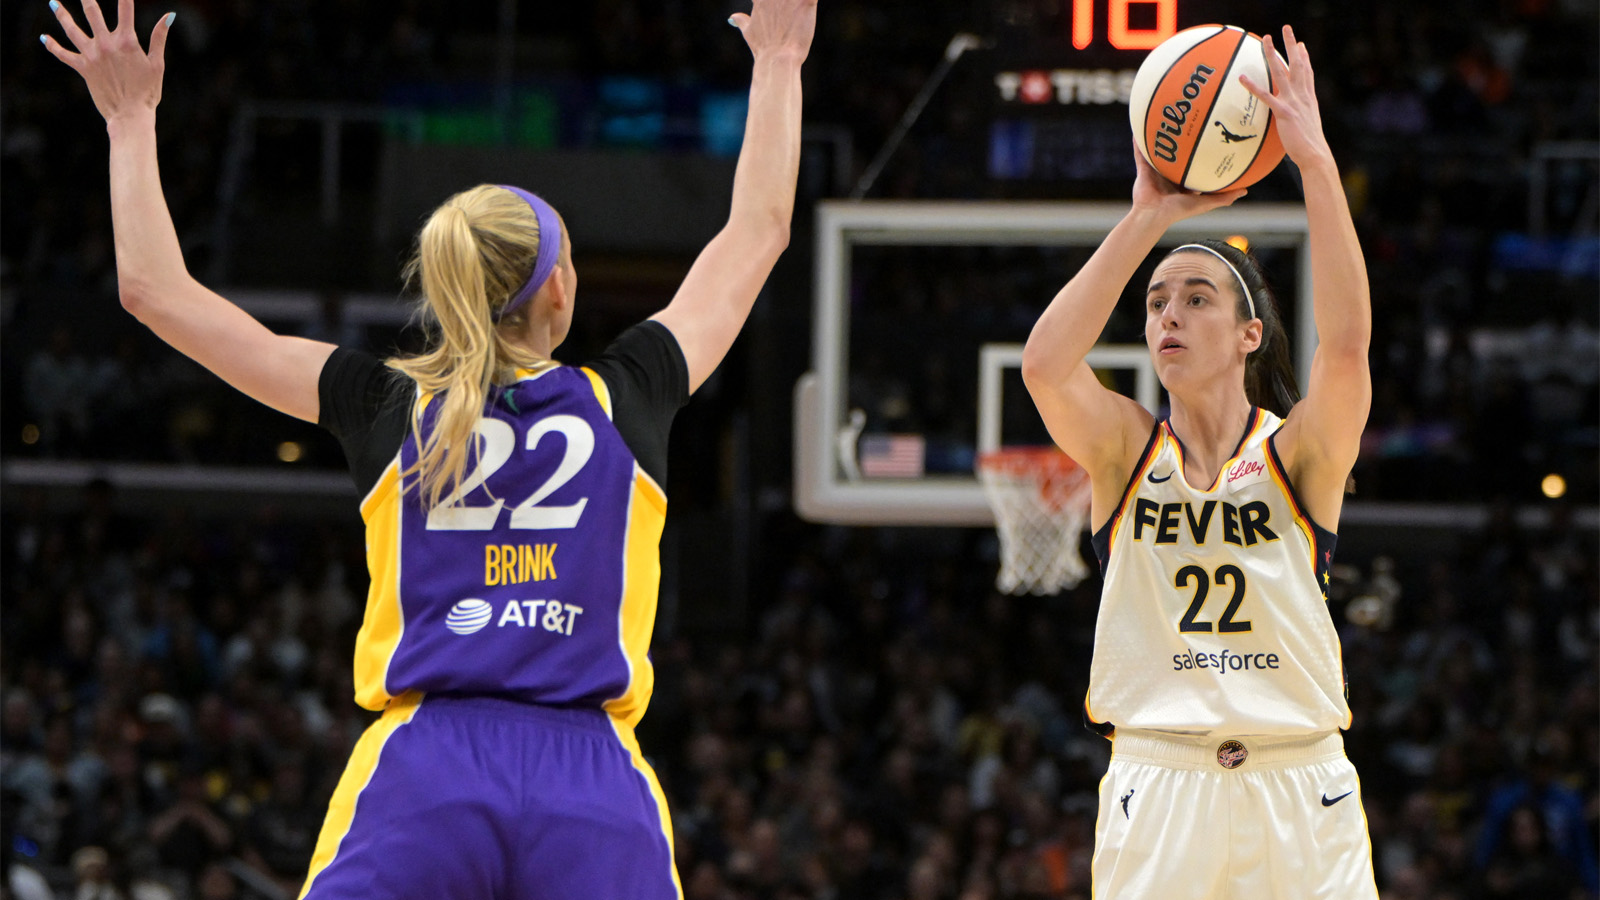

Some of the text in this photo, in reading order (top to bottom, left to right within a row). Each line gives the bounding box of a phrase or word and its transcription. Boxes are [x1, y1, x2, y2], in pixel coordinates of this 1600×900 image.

[1154, 63, 1215, 163] Wilson
[425, 414, 595, 531] 22
[1227, 460, 1265, 483] Lilly
[1133, 497, 1282, 549] FEVER
[485, 543, 558, 587] BRINK
[497, 600, 584, 637] AT&T
[1174, 564, 1253, 635] 22
[1172, 648, 1280, 675] salesforce
